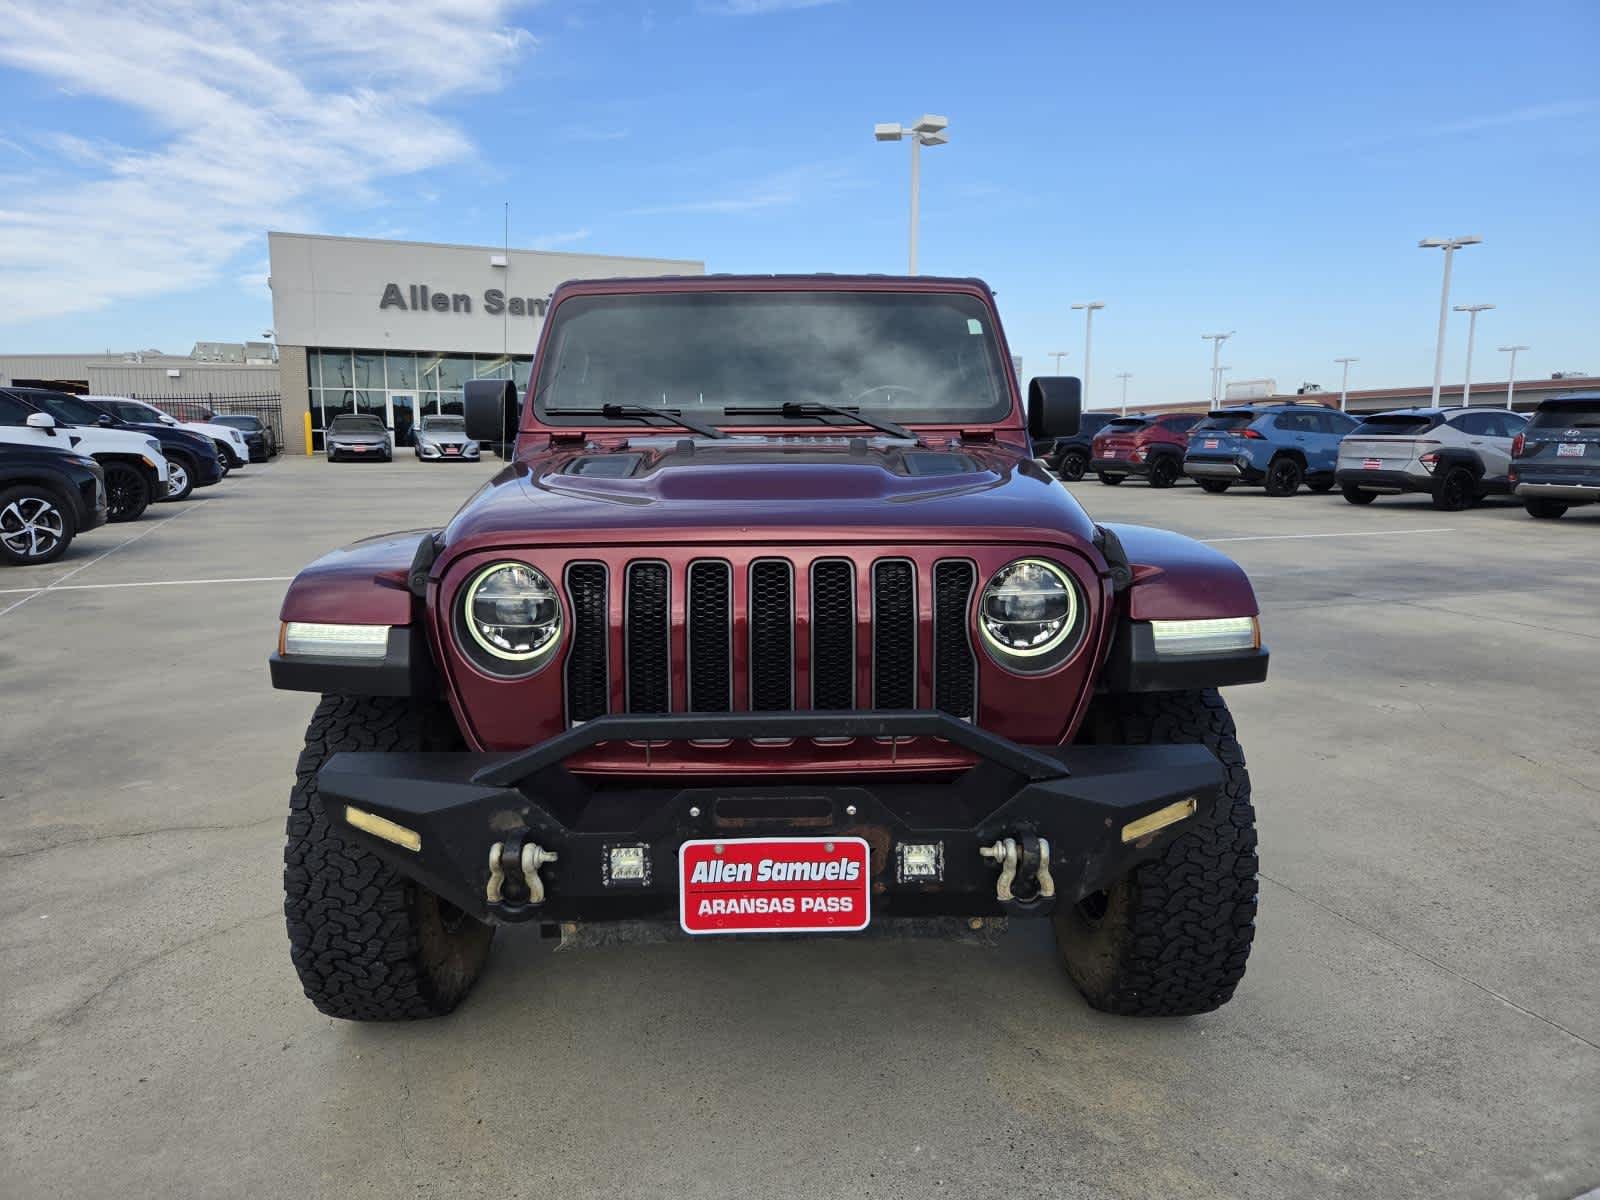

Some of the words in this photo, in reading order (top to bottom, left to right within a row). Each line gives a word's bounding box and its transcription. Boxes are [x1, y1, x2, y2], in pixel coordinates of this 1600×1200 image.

[379, 283, 472, 313] Allen
[483, 289, 552, 316] Sam
[690, 860, 752, 884] Allen
[756, 857, 861, 882] Samuels
[698, 898, 796, 915] ARANSAS
[801, 896, 853, 912] PASS
